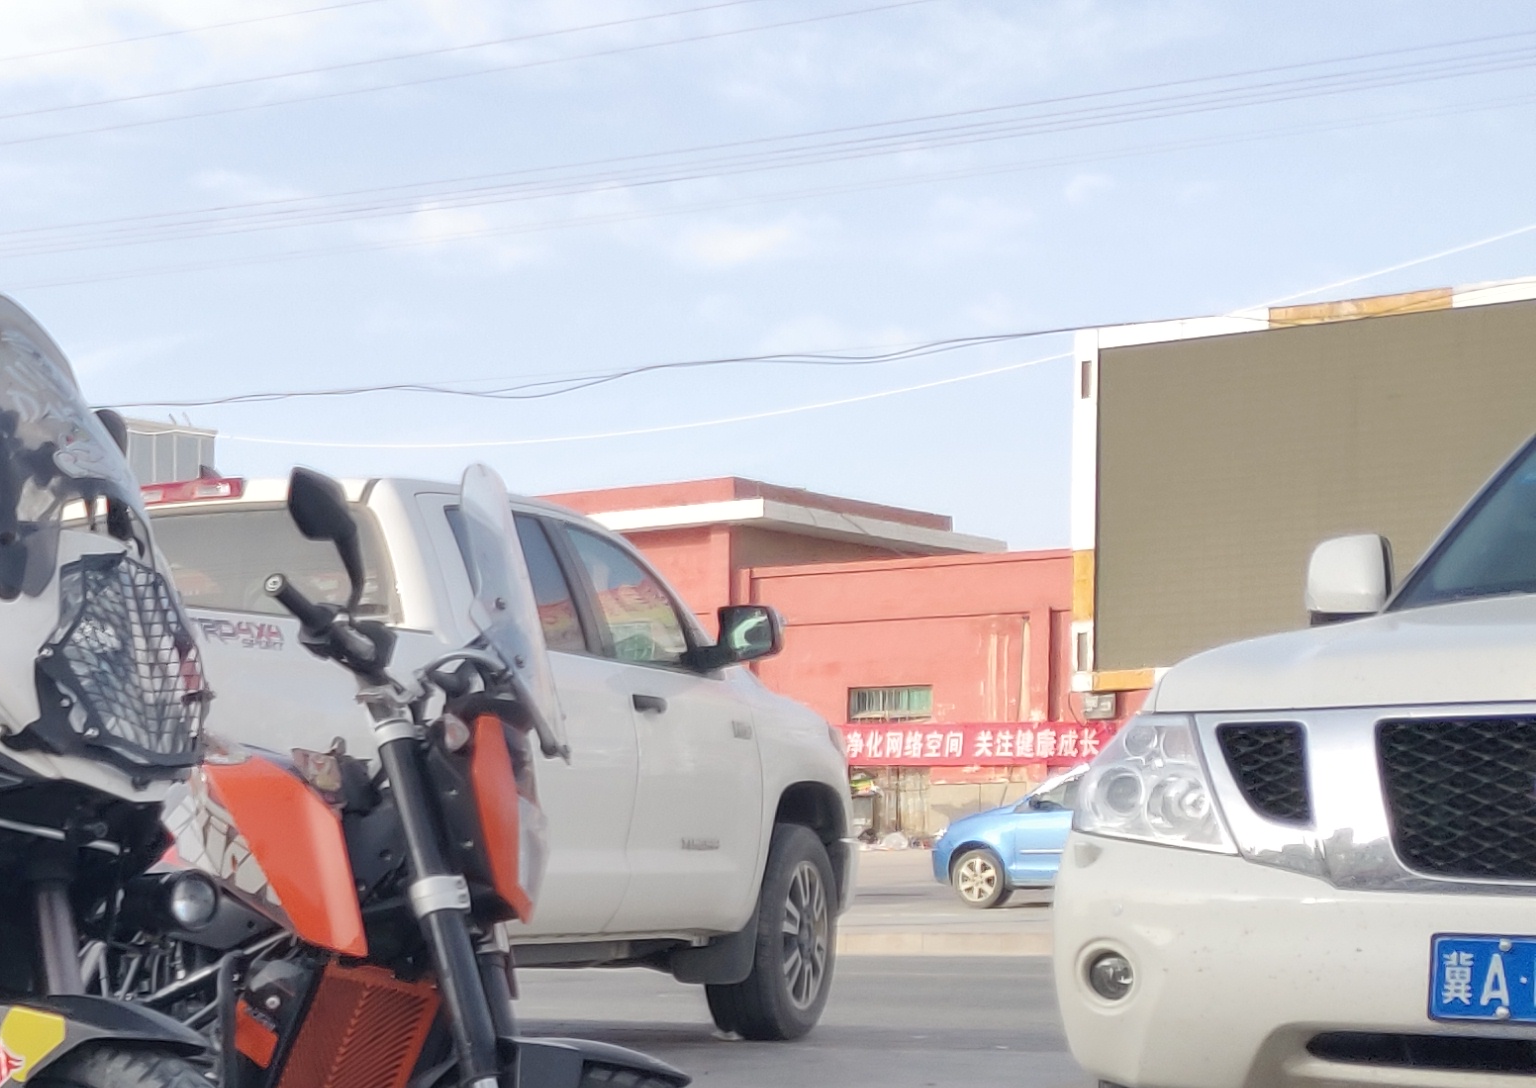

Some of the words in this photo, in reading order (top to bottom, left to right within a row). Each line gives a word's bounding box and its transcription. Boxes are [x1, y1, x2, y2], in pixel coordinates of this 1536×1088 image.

[846, 729, 964, 758] 净化网络空间
[974, 729, 1101, 758] 关注健康成长
